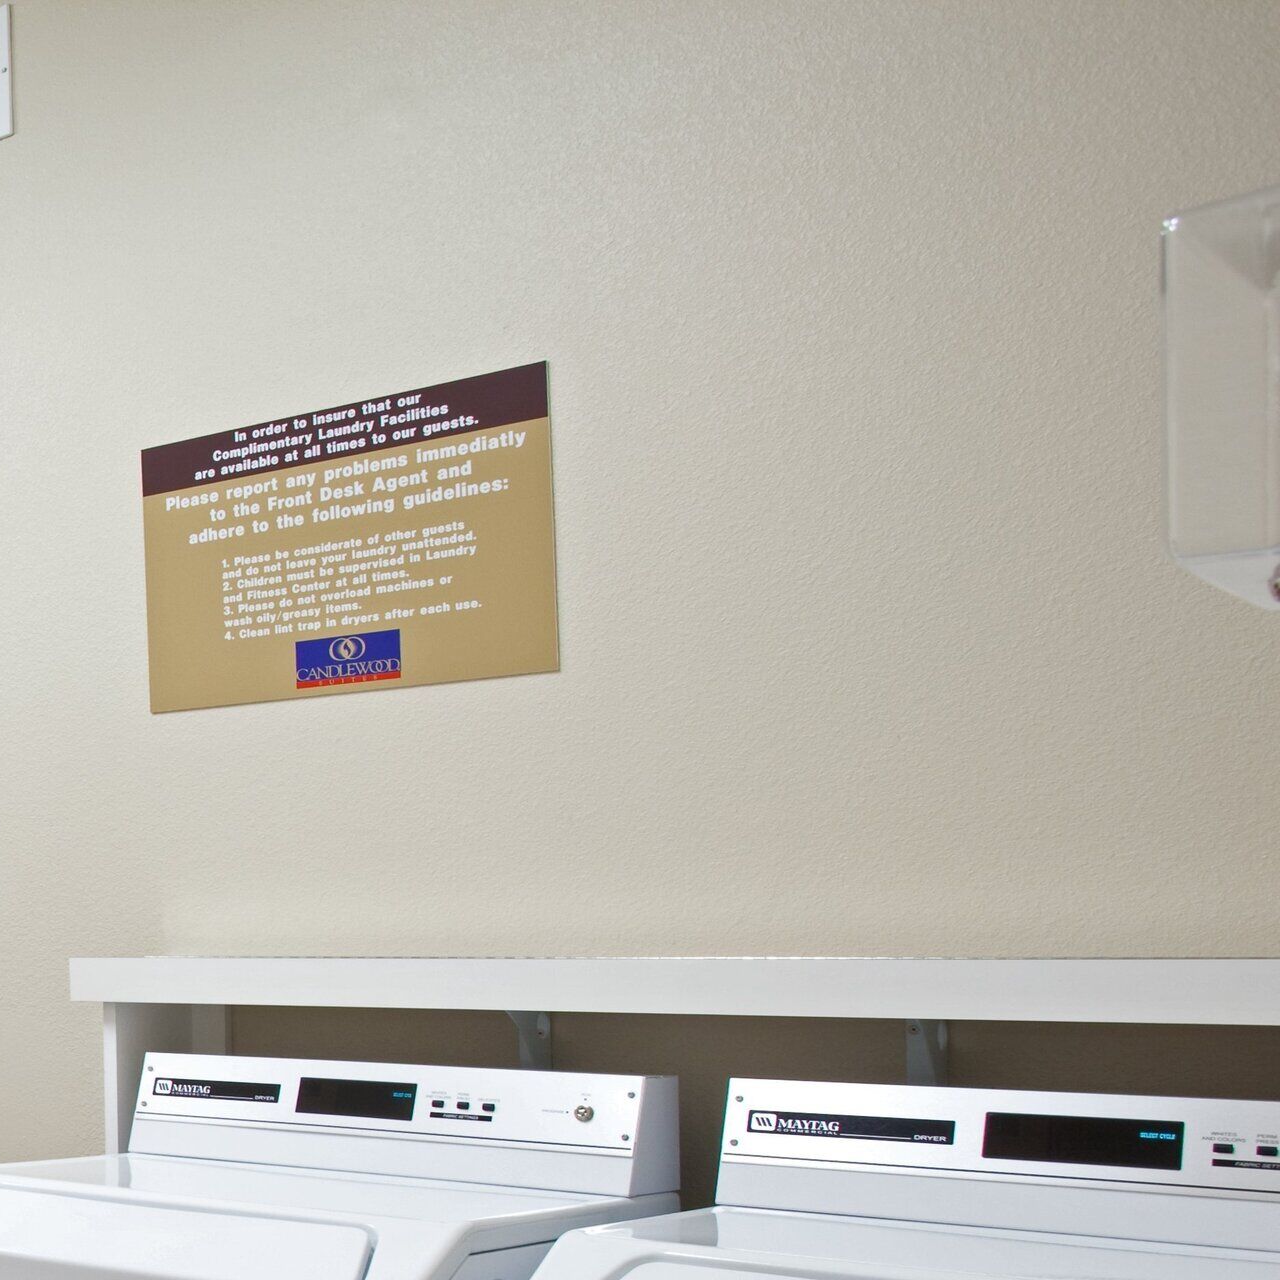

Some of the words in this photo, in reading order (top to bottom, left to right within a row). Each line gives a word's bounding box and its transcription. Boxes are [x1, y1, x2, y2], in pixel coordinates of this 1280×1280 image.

[212, 432, 312, 462] Complimentary
[318, 420, 374, 440] Laundry
[380, 404, 449, 427] Facilities
[234, 431, 246, 442] In
[252, 422, 288, 438] order
[293, 419, 307, 430] to
[312, 408, 356, 426] insure
[362, 398, 392, 416] that
[397, 394, 422, 408] our
[194, 468, 216, 481] are
[220, 454, 278, 475] available
[284, 450, 298, 462] at
[304, 445, 321, 458] all
[326, 437, 366, 454] times
[372, 432, 386, 445] to
[392, 427, 416, 440] our
[422, 415, 479, 437] guests.
[166, 491, 219, 512] Please
[226, 478, 278, 499] report
[286, 472, 316, 488] any
[324, 454, 408, 484] problems
[416, 430, 526, 464] immediatly
[210, 508, 226, 522] to
[233, 502, 260, 518] the
[268, 491, 312, 512] Front
[320, 481, 364, 502] Desk
[372, 469, 428, 492] Agent
[436, 460, 472, 481] and
[188, 524, 245, 544] adhere
[252, 519, 270, 534] to
[276, 514, 304, 530] the
[312, 498, 395, 523] following
[403, 478, 510, 510] guidelines:
[222, 559, 230, 568] 1.
[234, 552, 271, 566] Please
[275, 550, 289, 560] be
[294, 538, 362, 557] considerate
[367, 534, 380, 544] of
[384, 528, 416, 542] other
[422, 520, 465, 538] guests
[222, 568, 242, 580] and
[246, 566, 259, 575] do
[264, 562, 282, 573] not
[286, 558, 316, 570] leave
[321, 552, 347, 566] your
[352, 544, 397, 560] laundry
[402, 530, 477, 551] unattended.
[222, 582, 233, 592] 2.
[236, 575, 282, 590] Children
[286, 570, 315, 582] must
[319, 567, 334, 577] be
[338, 555, 404, 574] supervised
[409, 553, 421, 563] in
[426, 544, 477, 560] Laundry
[223, 592, 243, 604] and
[246, 587, 288, 601] Fitness
[292, 580, 330, 594] Center
[335, 578, 348, 588] at
[352, 574, 367, 585] all
[372, 569, 410, 582] times.
[223, 606, 234, 616] 3.
[238, 602, 275, 614] Please
[279, 598, 293, 608] do
[297, 595, 316, 605] not
[320, 586, 371, 602] overload
[376, 578, 434, 594] machines
[439, 576, 453, 585] or
[224, 616, 253, 628] wash
[256, 606, 320, 624] oily/greasy
[326, 602, 362, 614] items.
[224, 631, 235, 640] 4.
[239, 626, 270, 639] Clean
[274, 624, 293, 634] lint
[298, 620, 321, 632] trap
[326, 618, 336, 628] in
[341, 612, 380, 627] dryers
[384, 607, 415, 620] after
[420, 602, 450, 616] each
[454, 599, 482, 610] use.
[296, 658, 400, 682] CANDLEWOOD
[172, 1084, 212, 1094] MAYTAG
[776, 1128, 838, 1136] COMMERCIAL
[914, 1134, 947, 1142] DRYER
[777, 1118, 840, 1132] MAYTAG
[1160, 1132, 1176, 1140] CYCLE
